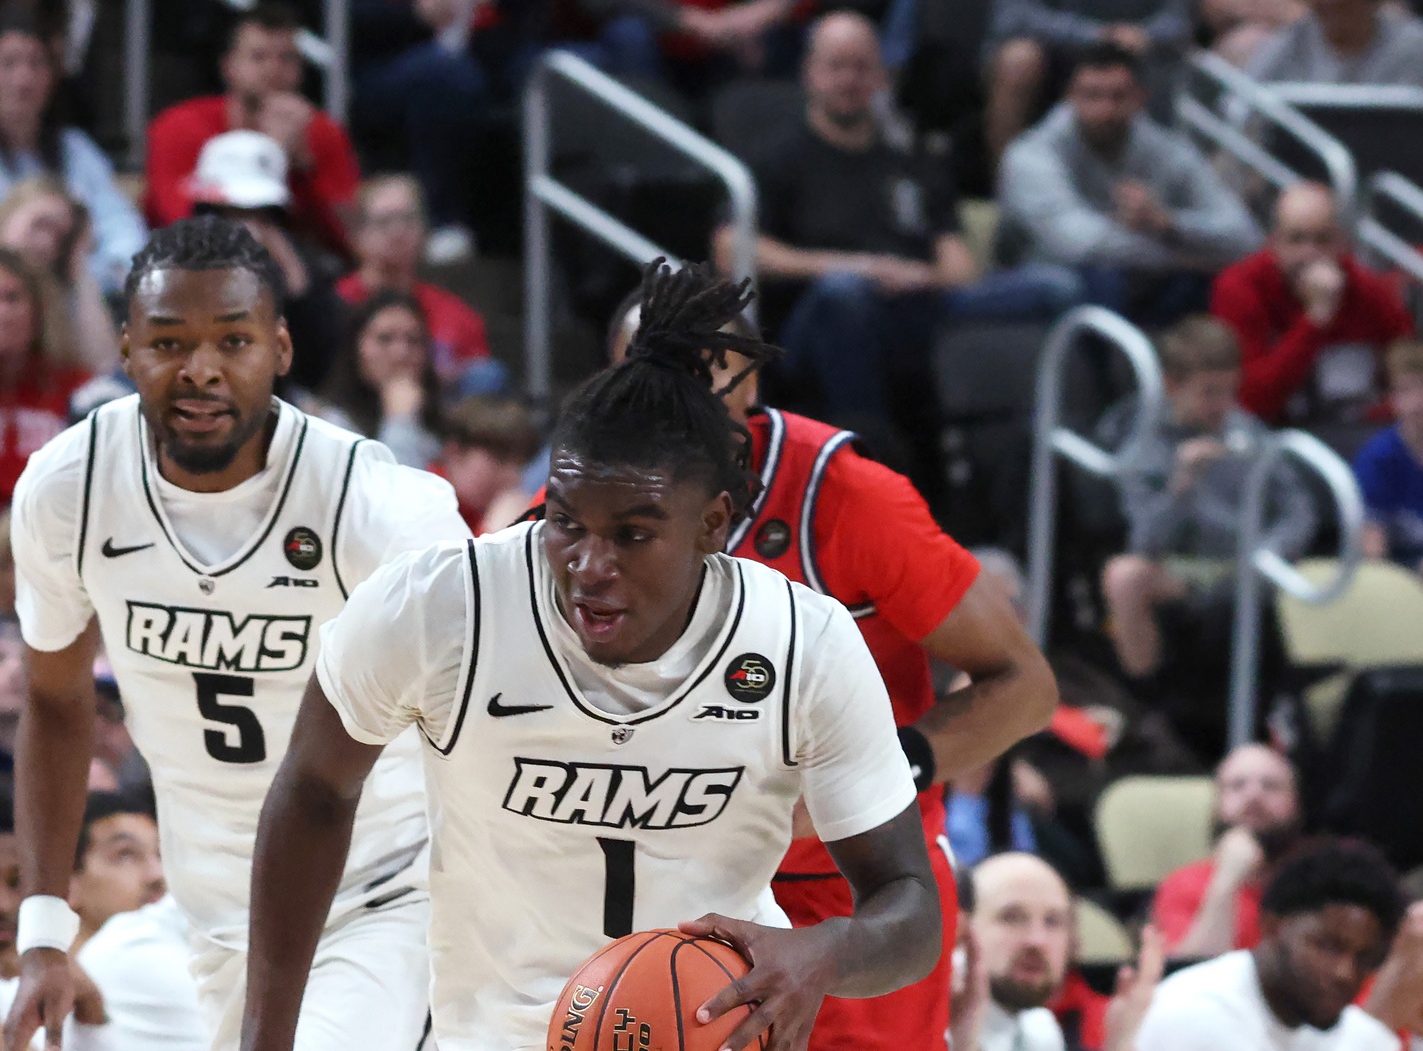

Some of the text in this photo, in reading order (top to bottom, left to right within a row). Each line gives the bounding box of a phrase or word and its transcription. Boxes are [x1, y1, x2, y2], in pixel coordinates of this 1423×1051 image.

[126, 600, 312, 672] RAMS
[192, 672, 266, 763] 5
[692, 706, 759, 720] A10
[502, 757, 745, 830] RAMS
[596, 837, 635, 939] 1
